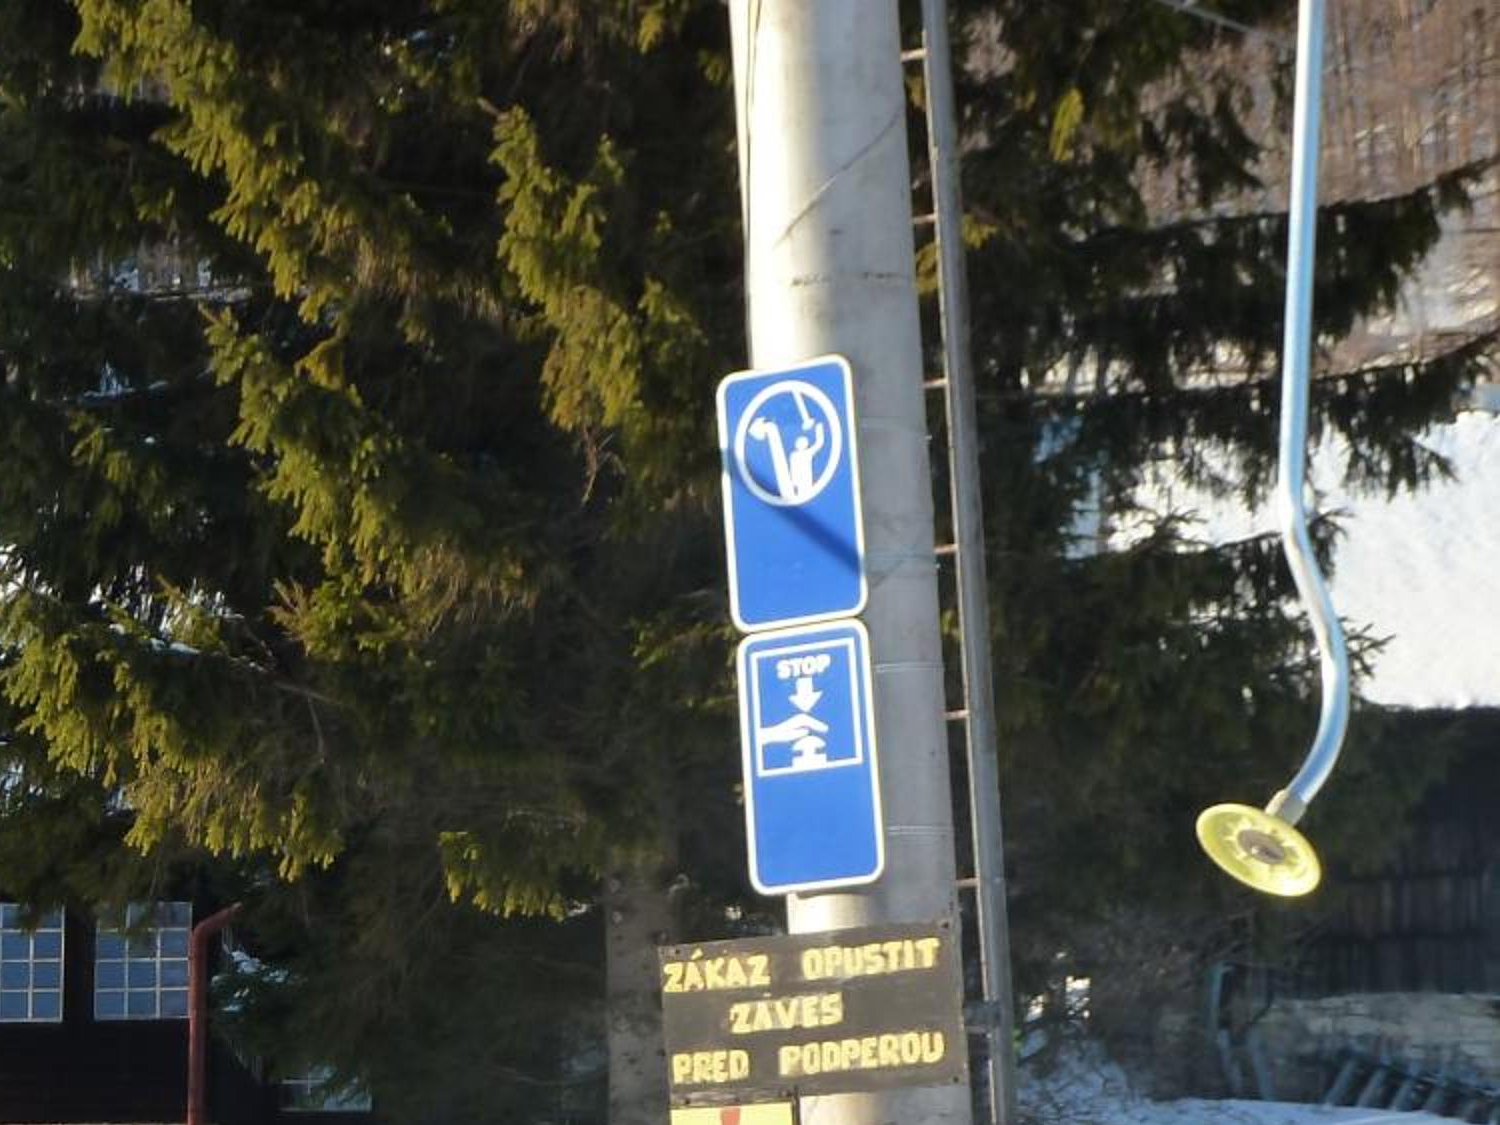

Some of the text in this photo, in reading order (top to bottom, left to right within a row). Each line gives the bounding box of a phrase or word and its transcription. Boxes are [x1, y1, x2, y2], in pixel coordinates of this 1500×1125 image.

[776, 654, 831, 679] STOP
[663, 937, 941, 993] ZÁKAZ OPUSTIT
[672, 1031, 946, 1085] PRED PODPEROU
